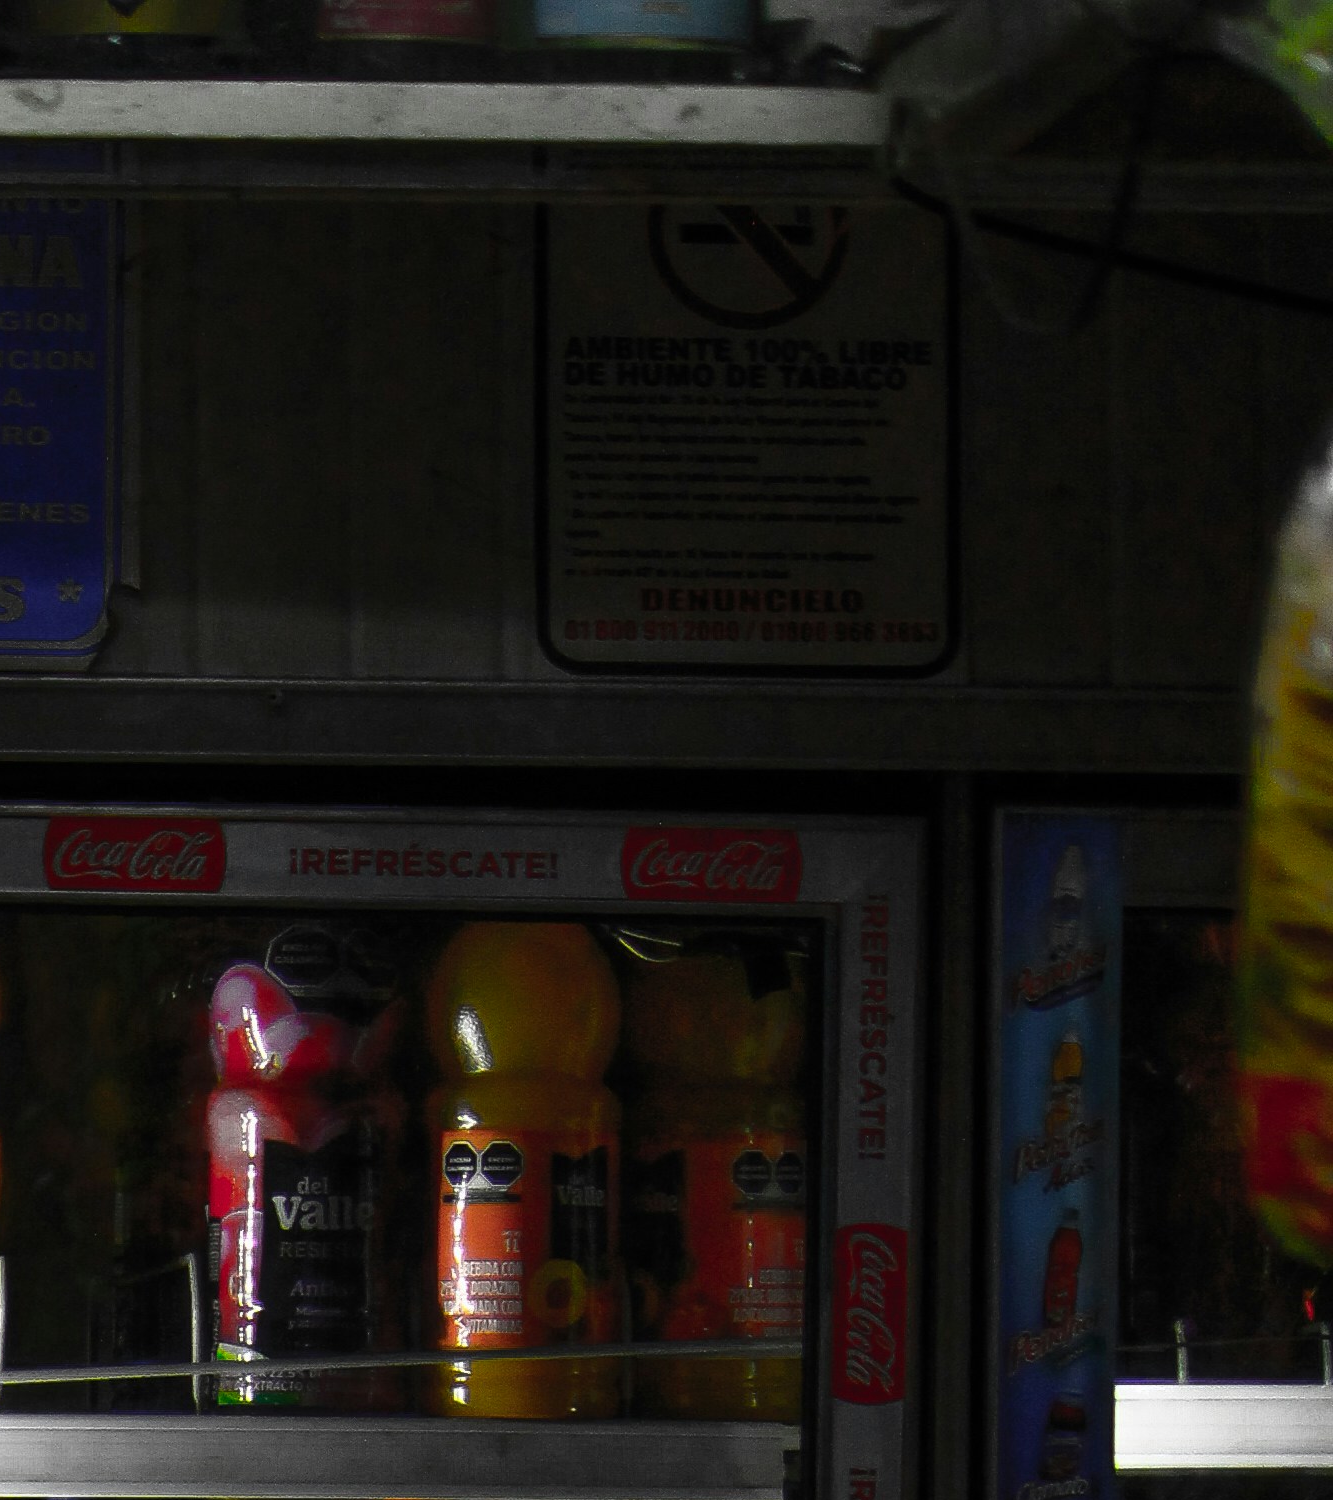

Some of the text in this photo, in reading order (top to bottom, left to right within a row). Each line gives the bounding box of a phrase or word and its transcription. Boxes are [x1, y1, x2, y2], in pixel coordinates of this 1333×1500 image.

[564, 335, 933, 366] AMBIENTE 100% LIBRE
[564, 361, 908, 391] DE HUMO DE TABACO
